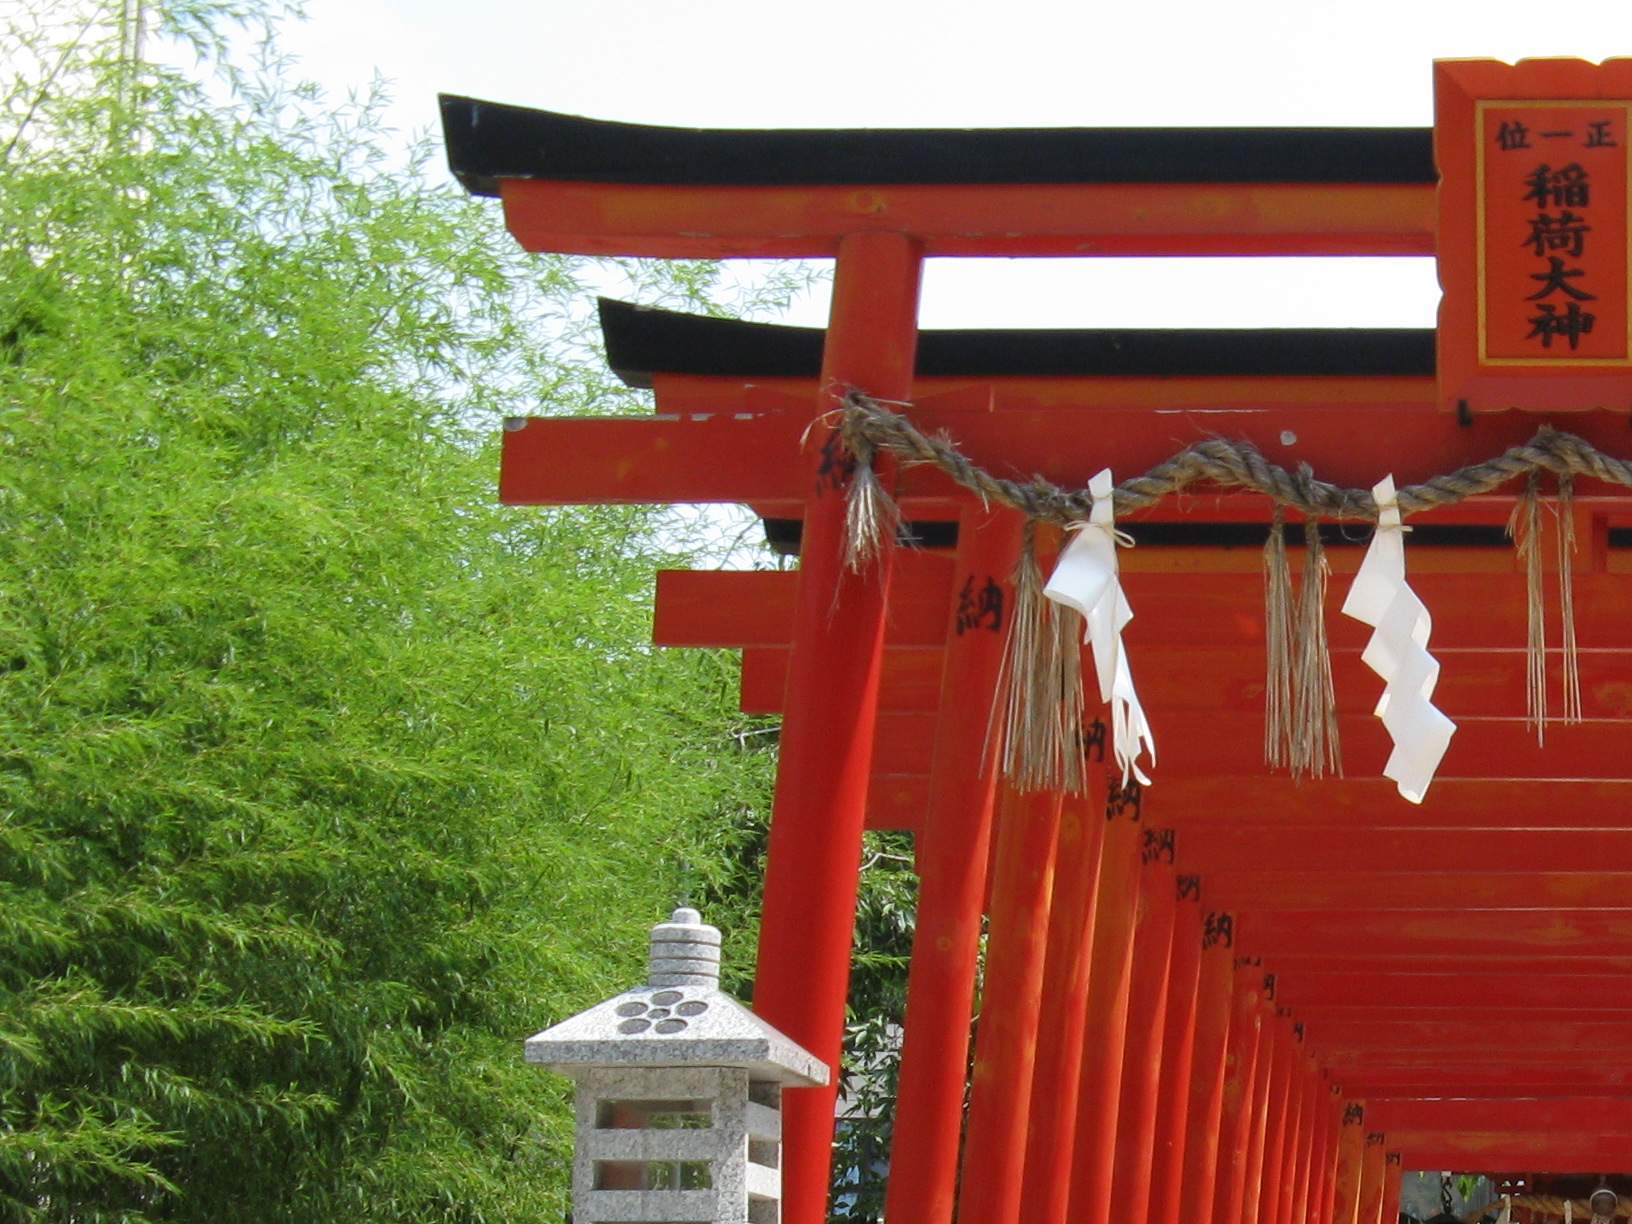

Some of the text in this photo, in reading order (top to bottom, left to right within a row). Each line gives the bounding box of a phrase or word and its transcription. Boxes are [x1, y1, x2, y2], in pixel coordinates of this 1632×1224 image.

[1495, 120, 1618, 151] 正一位
[956, 575, 1004, 636] 納
